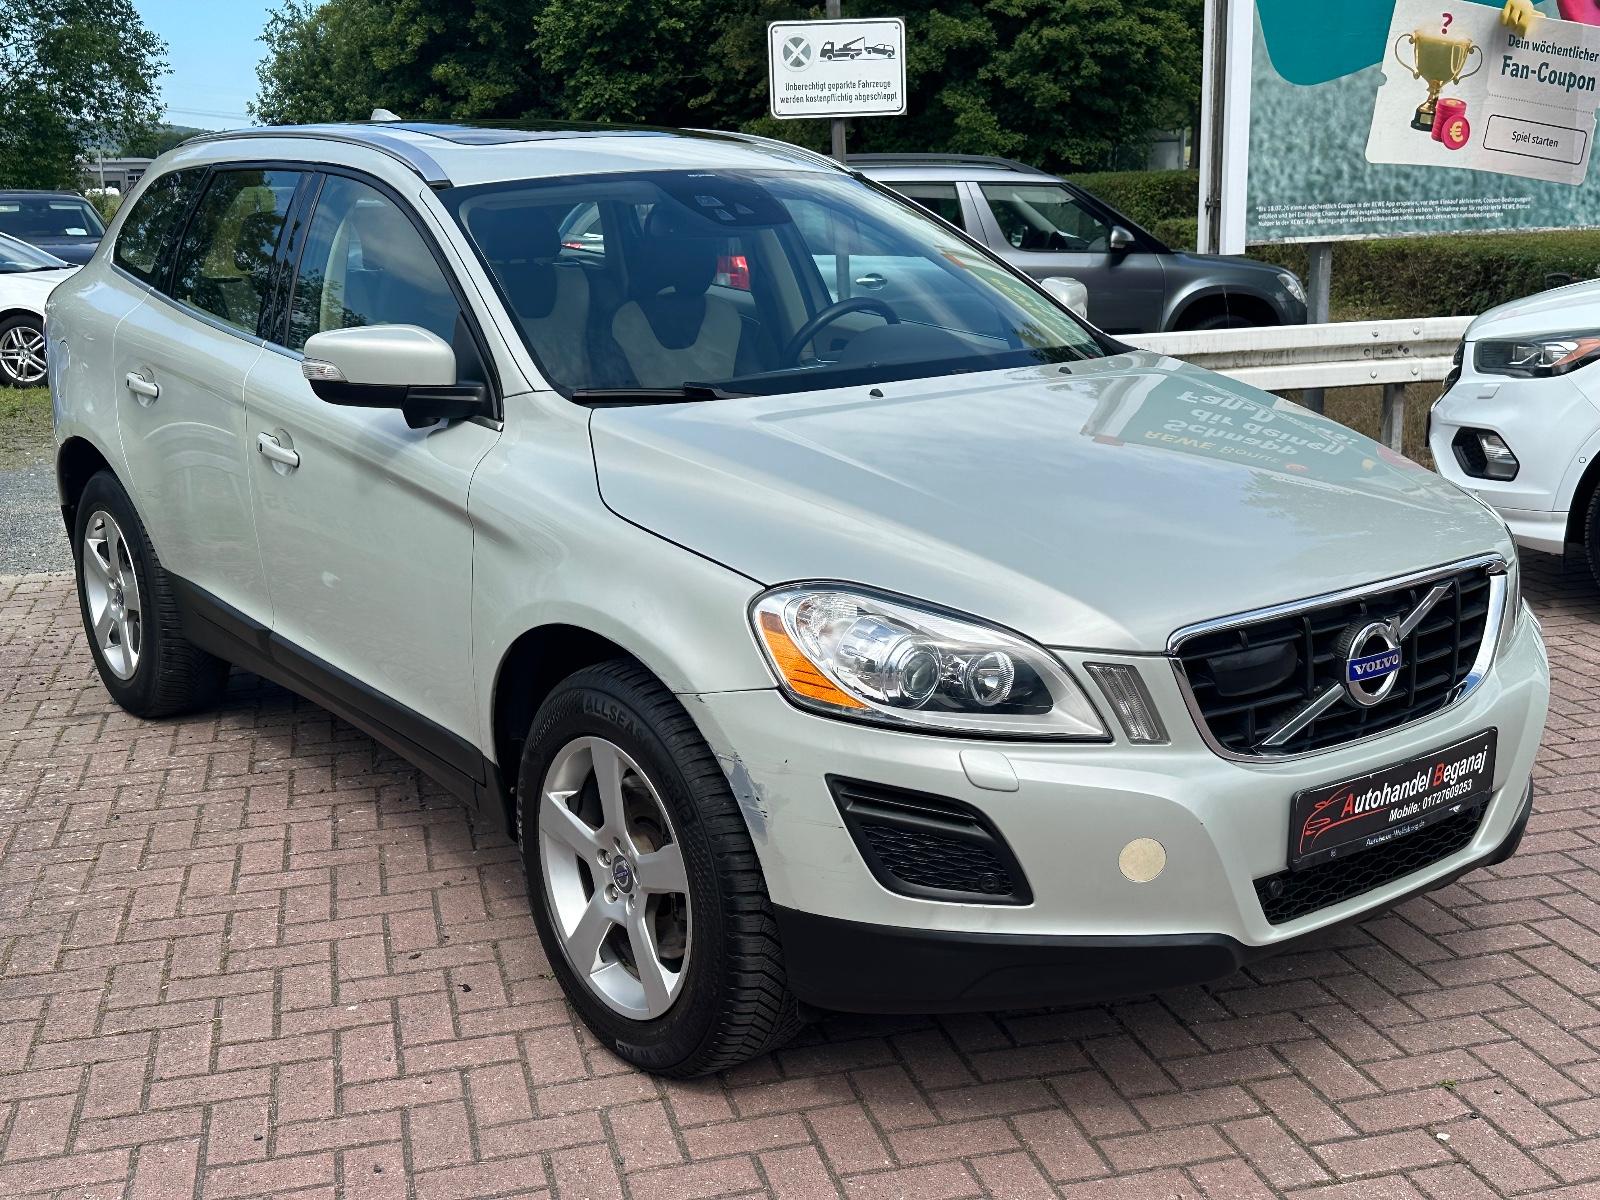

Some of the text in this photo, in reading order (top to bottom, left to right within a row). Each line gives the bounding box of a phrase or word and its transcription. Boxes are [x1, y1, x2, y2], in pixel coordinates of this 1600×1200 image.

[1508, 34, 1600, 62] Dein wöchentlicher
[785, 79, 892, 91] Unberechtigt geparkte Fahrzeuge
[1501, 55, 1596, 93] Fan-Coupon
[780, 91, 898, 104] werden kostenpflichtig abgeschleppt
[1511, 130, 1560, 148] Spiel starten
[1353, 654, 1399, 675] VOLVO
[1340, 744, 1488, 818] Autohandel Beganaj
[1388, 778, 1473, 822] Mobile: 01727609253
